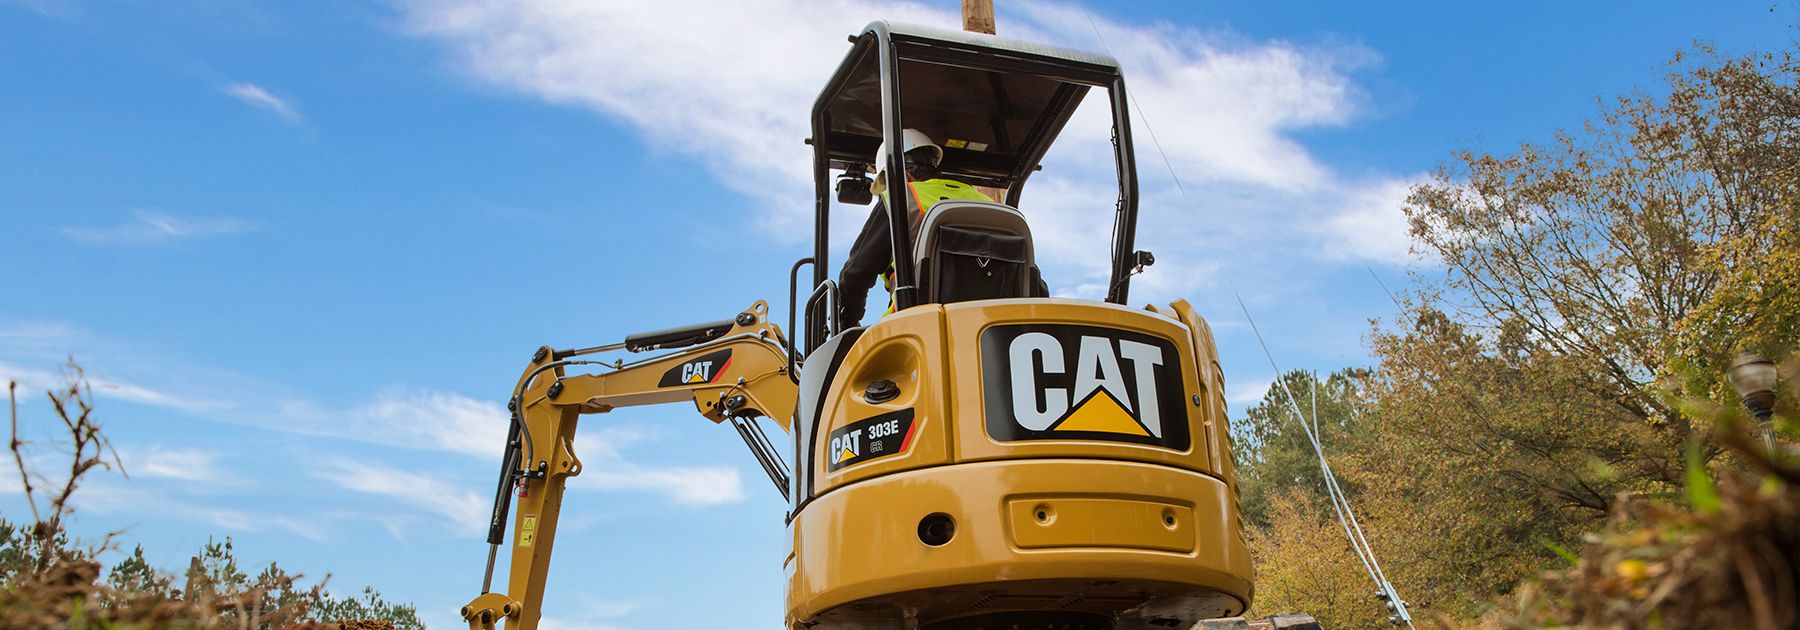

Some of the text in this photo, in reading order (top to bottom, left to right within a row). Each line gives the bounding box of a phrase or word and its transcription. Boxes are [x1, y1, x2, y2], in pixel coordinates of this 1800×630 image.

[681, 361, 712, 384] CAT
[1009, 332, 1164, 438] CAT
[831, 420, 899, 465] CAT 303E
